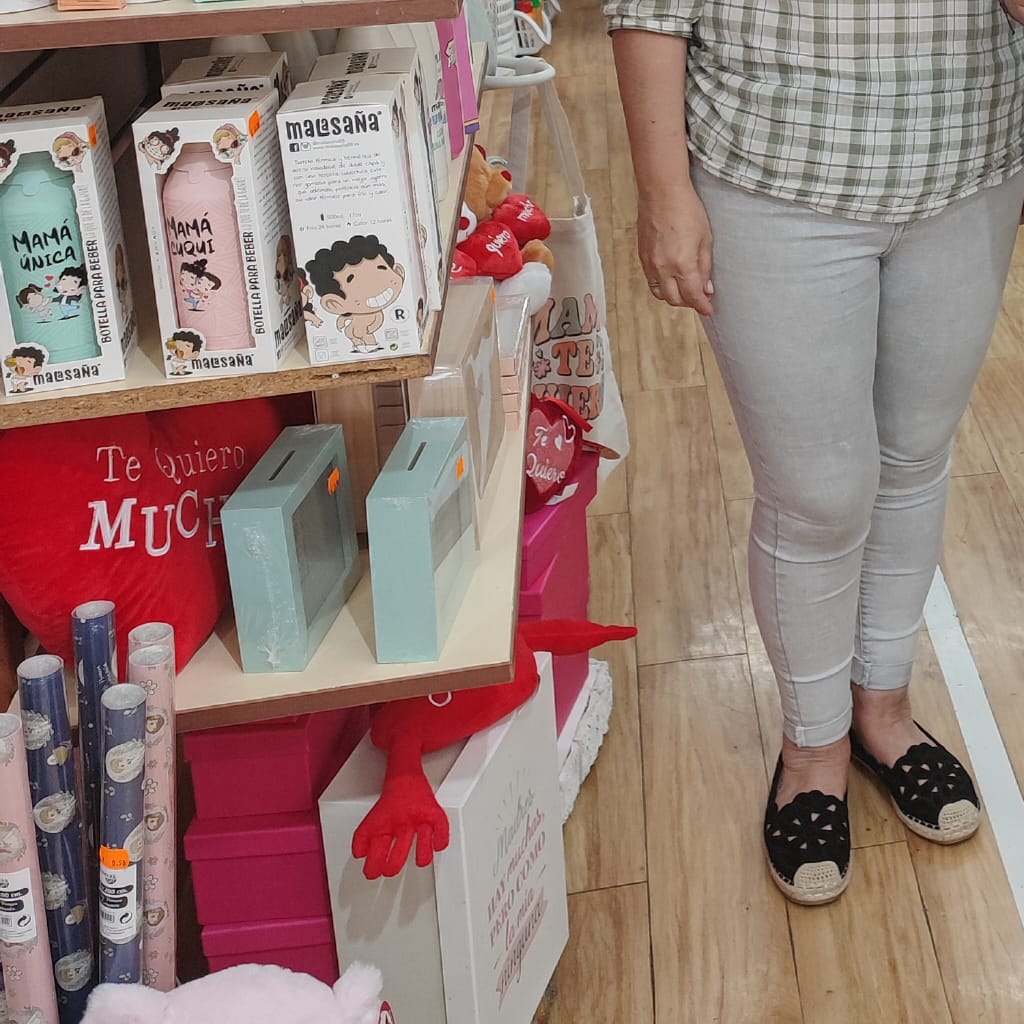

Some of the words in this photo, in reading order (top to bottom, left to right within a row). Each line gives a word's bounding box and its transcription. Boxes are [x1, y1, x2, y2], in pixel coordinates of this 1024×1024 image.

[12, 218, 73, 254] MAMÁ
[167, 211, 213, 240] MAMÁ
[19, 246, 77, 272] ÚNICA
[86, 239, 102, 271] BEBER
[243, 232, 257, 263] BEBER
[91, 272, 106, 298] PARA
[247, 264, 260, 290] PARA
[95, 300, 111, 343] BOTELLA
[250, 292, 265, 335] BOTELLA
[551, 339, 595, 377] TE
[97, 445, 142, 482] Te
[155, 440, 245, 484] Quiero
[79, 489, 229, 557] MUCH
[516, 831, 546, 893] COMO
